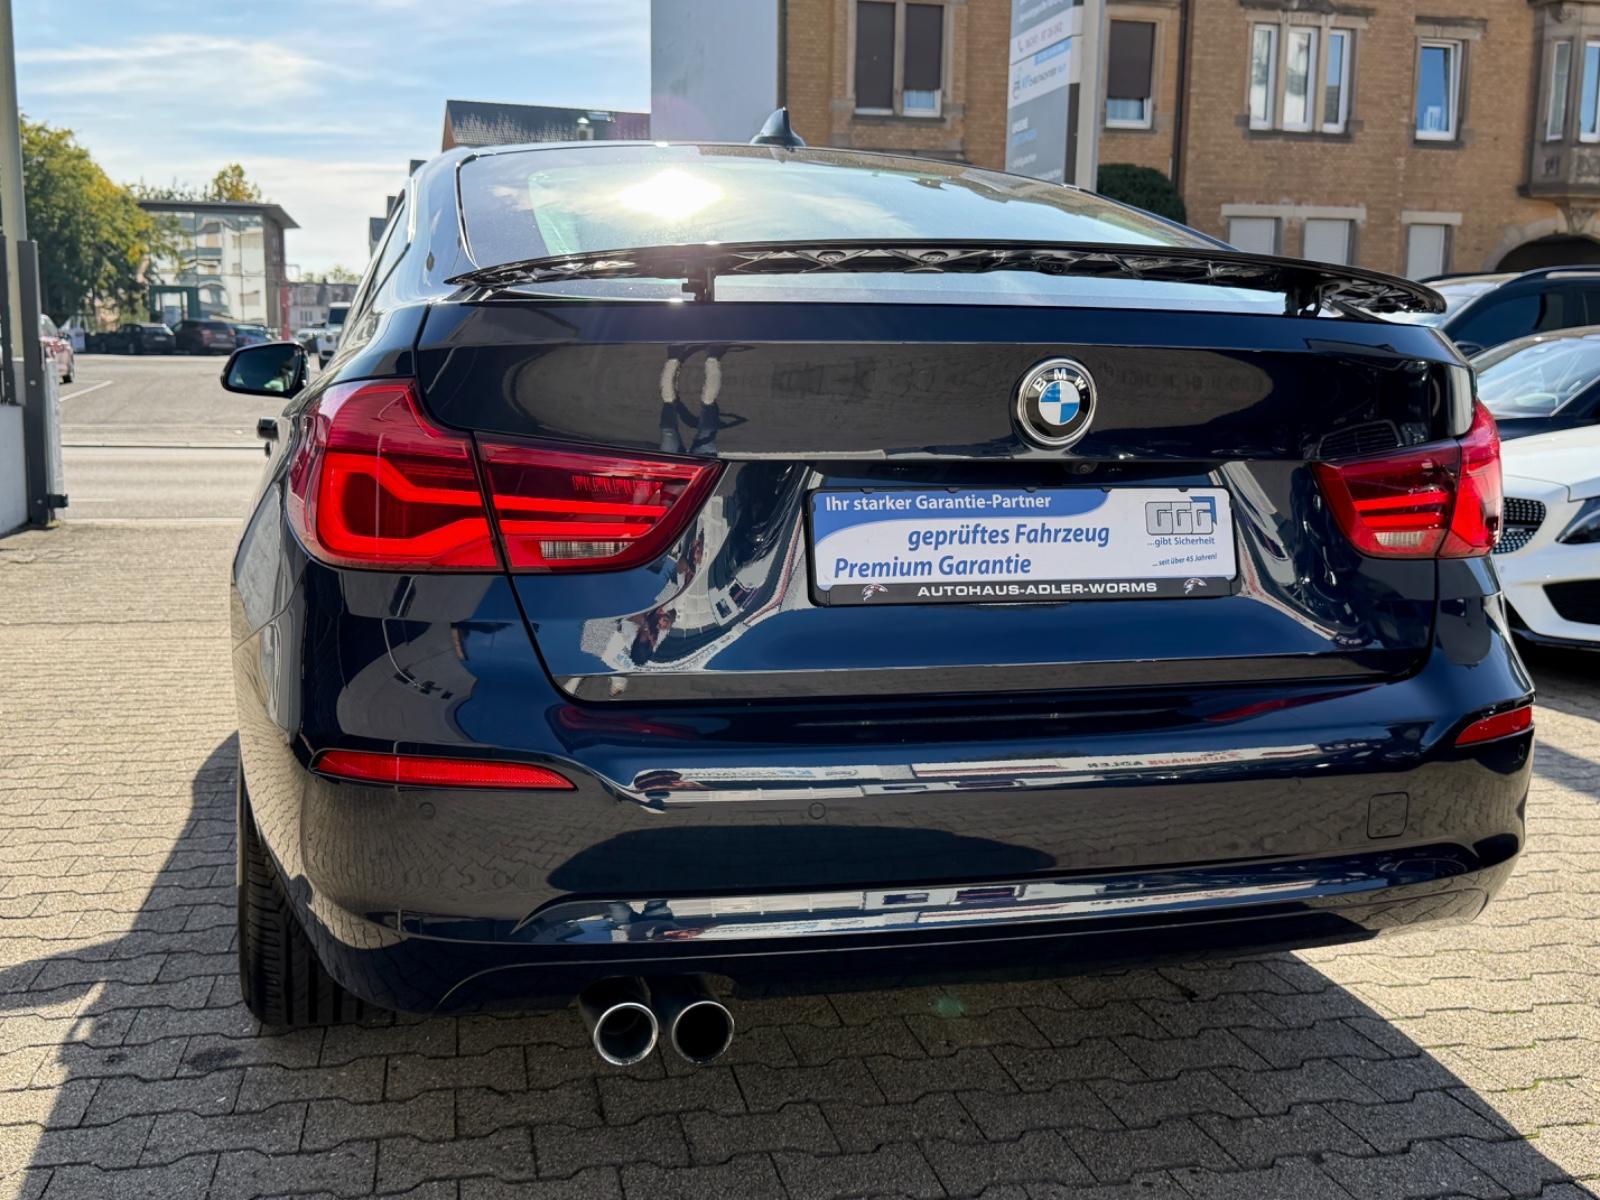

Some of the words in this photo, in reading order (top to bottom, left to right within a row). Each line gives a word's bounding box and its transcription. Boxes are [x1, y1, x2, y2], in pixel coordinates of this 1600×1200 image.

[1032, 368, 1087, 392] BMW
[826, 496, 849, 511] Ihr
[853, 495, 912, 511] starker
[915, 494, 1051, 510] Garantie-Partner
[908, 523, 1010, 551] geprüftes
[1015, 523, 1110, 548] Fahrzeug
[1174, 536, 1216, 545] Sicherheit
[834, 556, 932, 578] Premium
[938, 553, 1032, 577] Garantie
[917, 582, 1158, 597] AUTOHAUS-ADLER-WORMS
